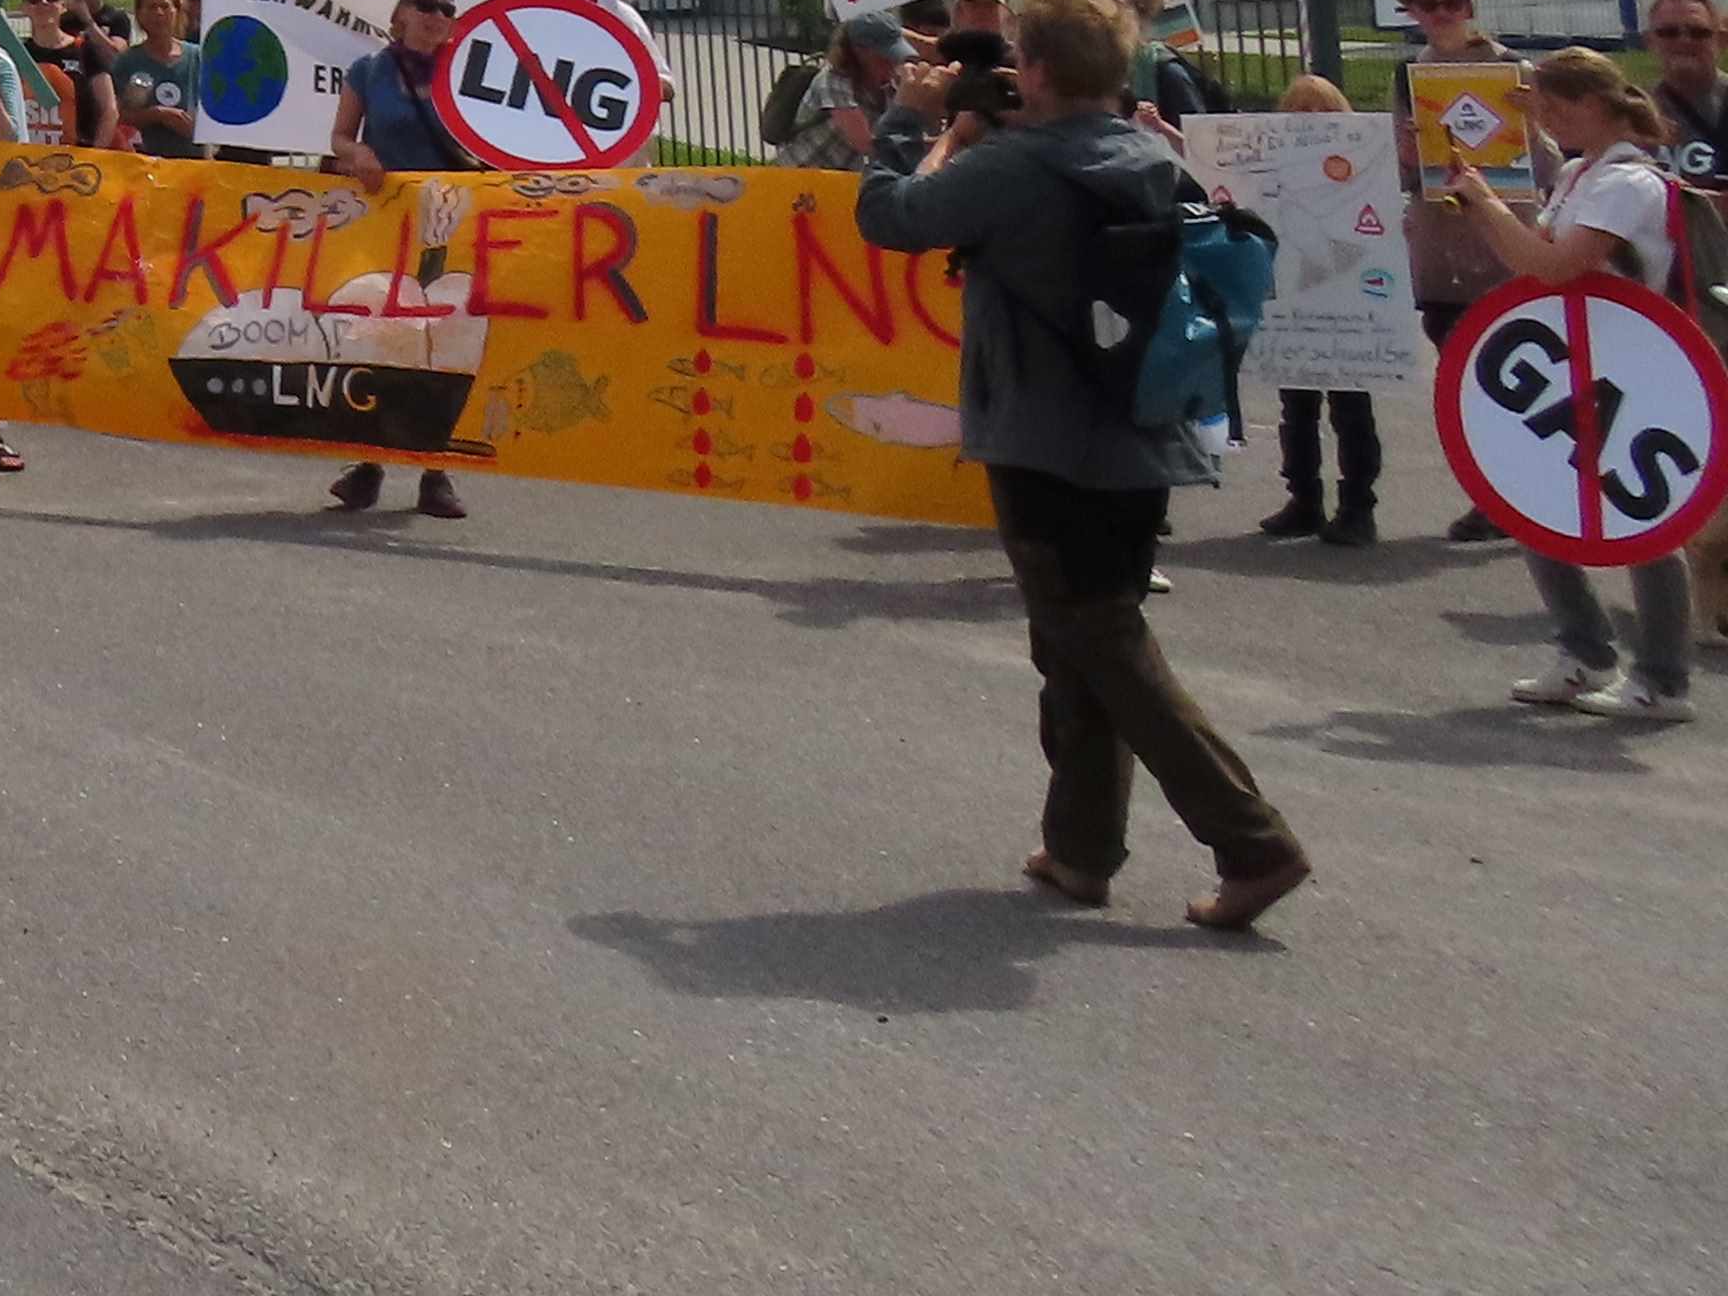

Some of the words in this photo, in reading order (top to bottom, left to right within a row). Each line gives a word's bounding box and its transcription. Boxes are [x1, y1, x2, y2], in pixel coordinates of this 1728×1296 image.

[458, 39, 633, 132] LNG
[271, 365, 377, 412] LNG
[1475, 317, 1703, 522] GAS
